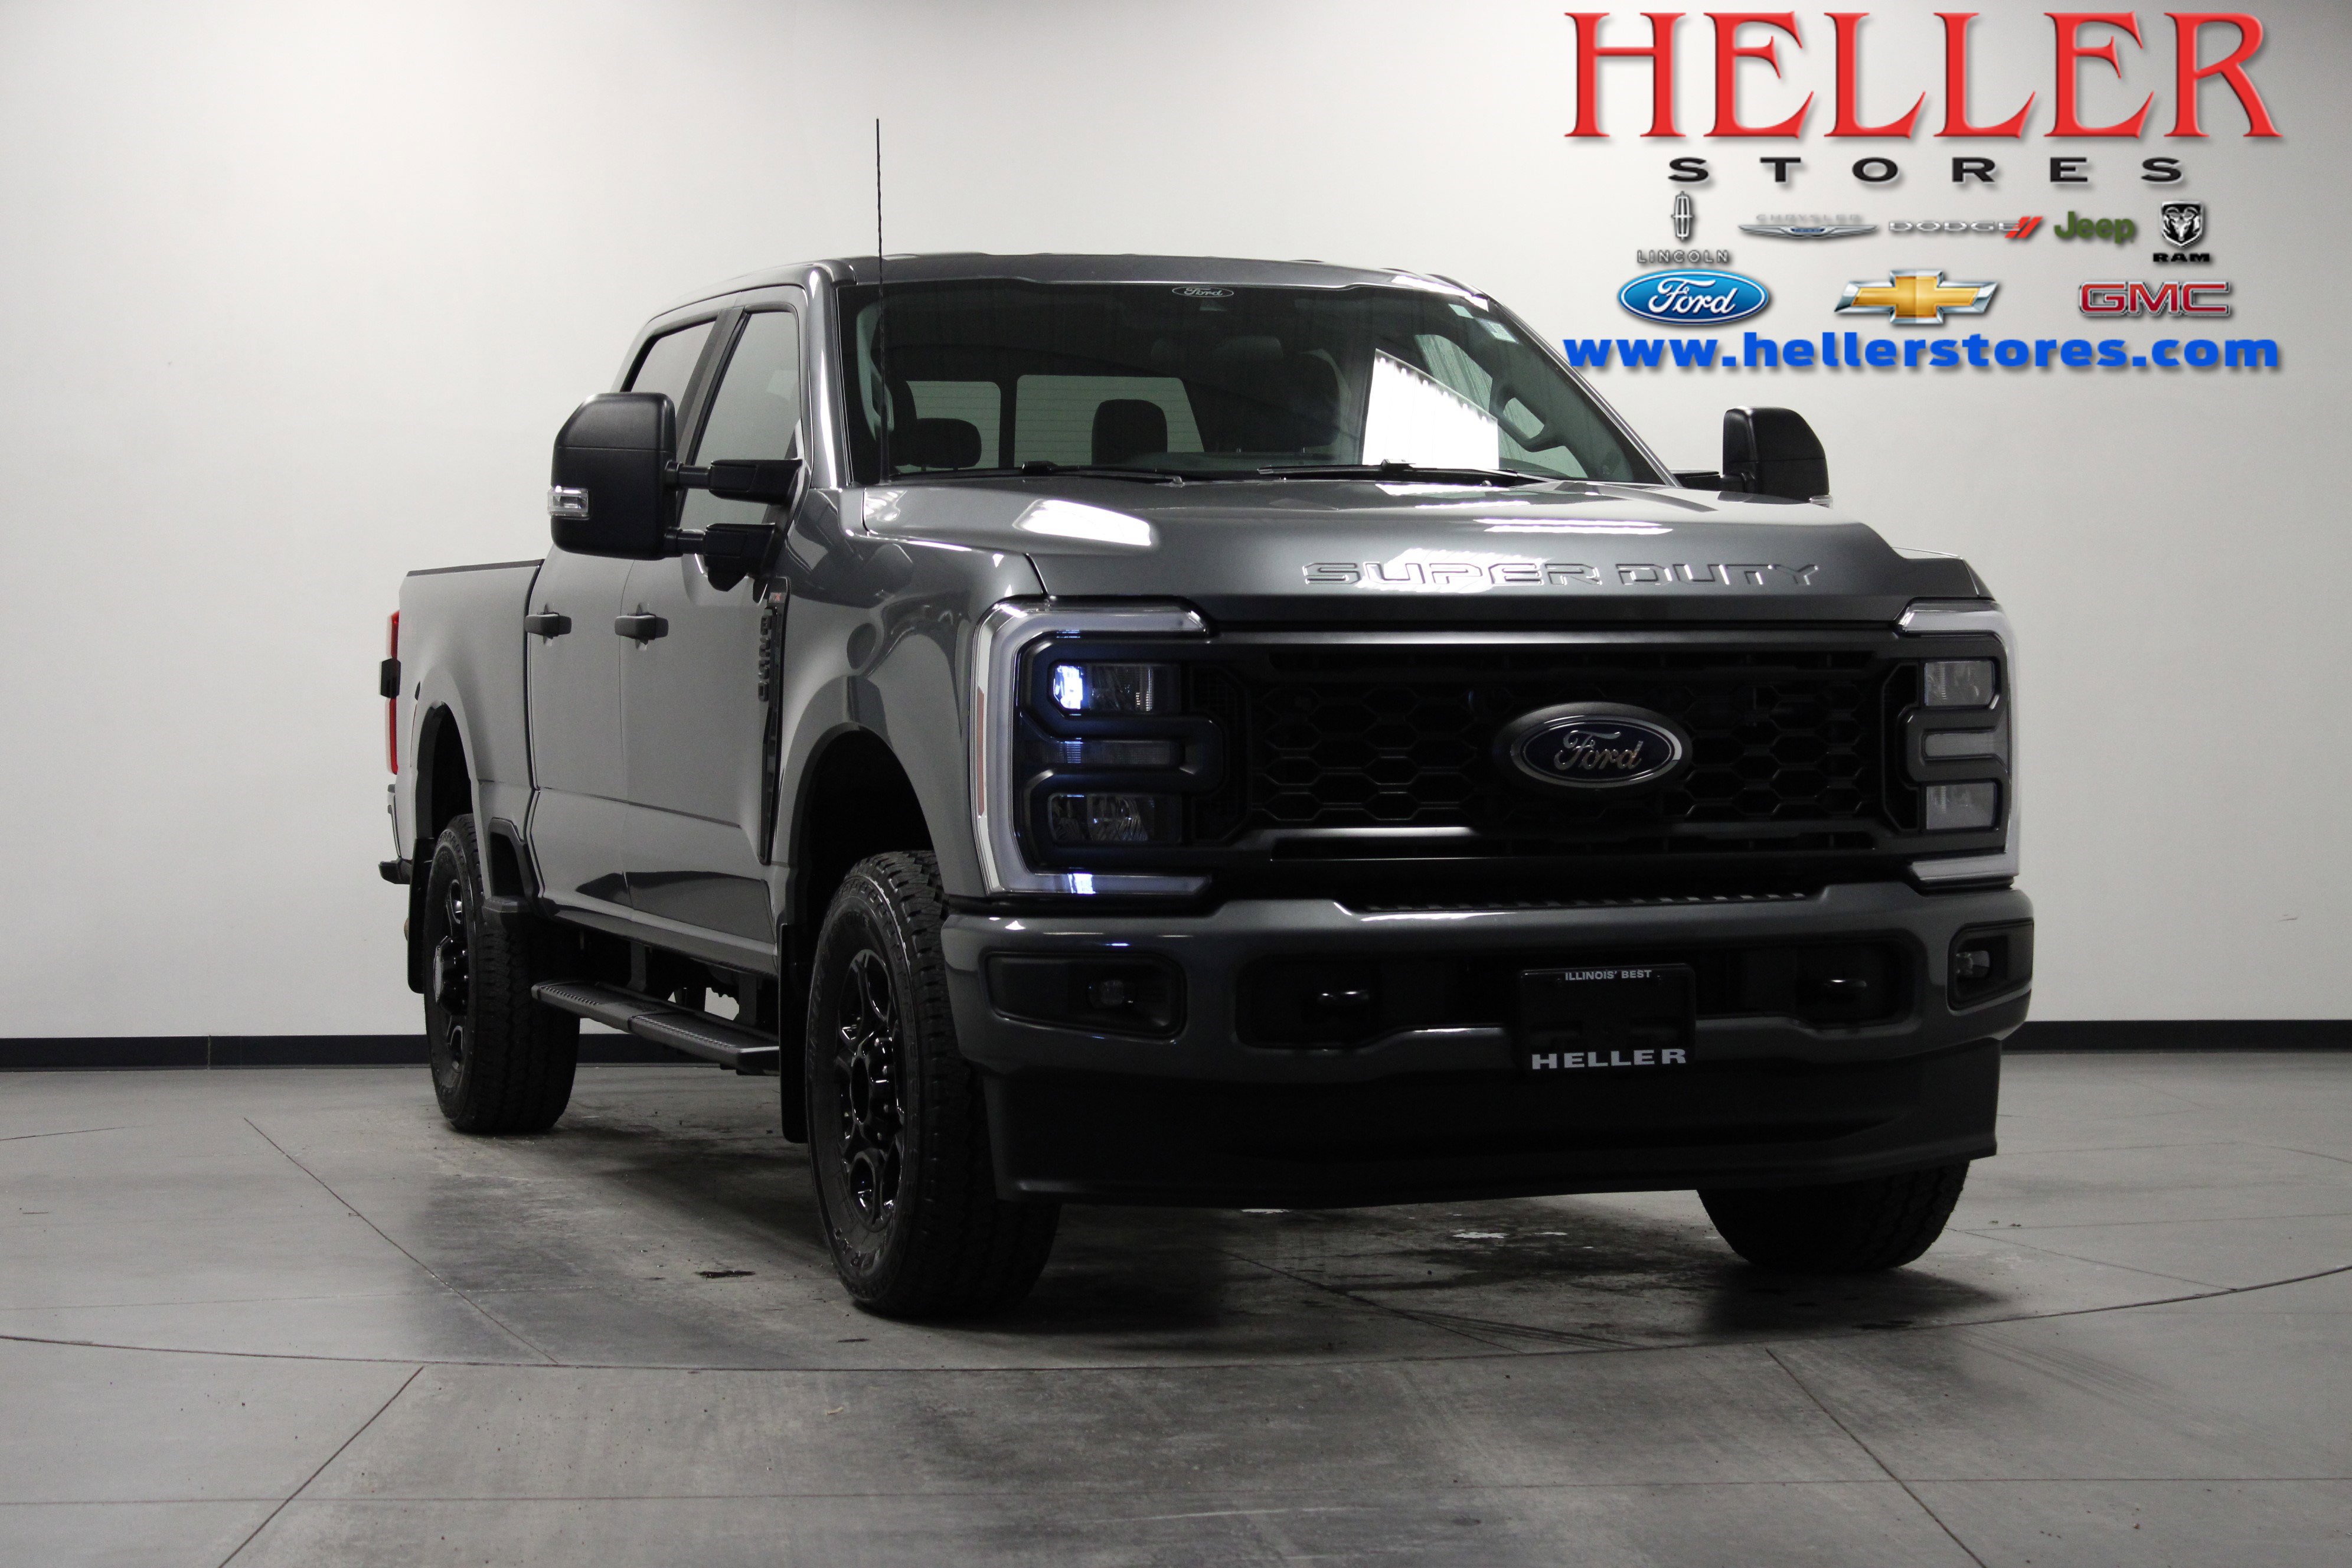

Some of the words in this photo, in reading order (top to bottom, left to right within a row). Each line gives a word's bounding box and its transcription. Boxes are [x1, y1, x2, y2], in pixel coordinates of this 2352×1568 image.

[1184, 287, 1223, 296] Ford
[1302, 562, 1602, 586] SUPER
[1614, 563, 1822, 586] DUTY
[1554, 730, 1645, 770] Ford
[1565, 971, 1618, 981] ILLINOIS'
[1621, 969, 1652, 979] BEST
[1531, 1048, 1687, 1070] HELLER
